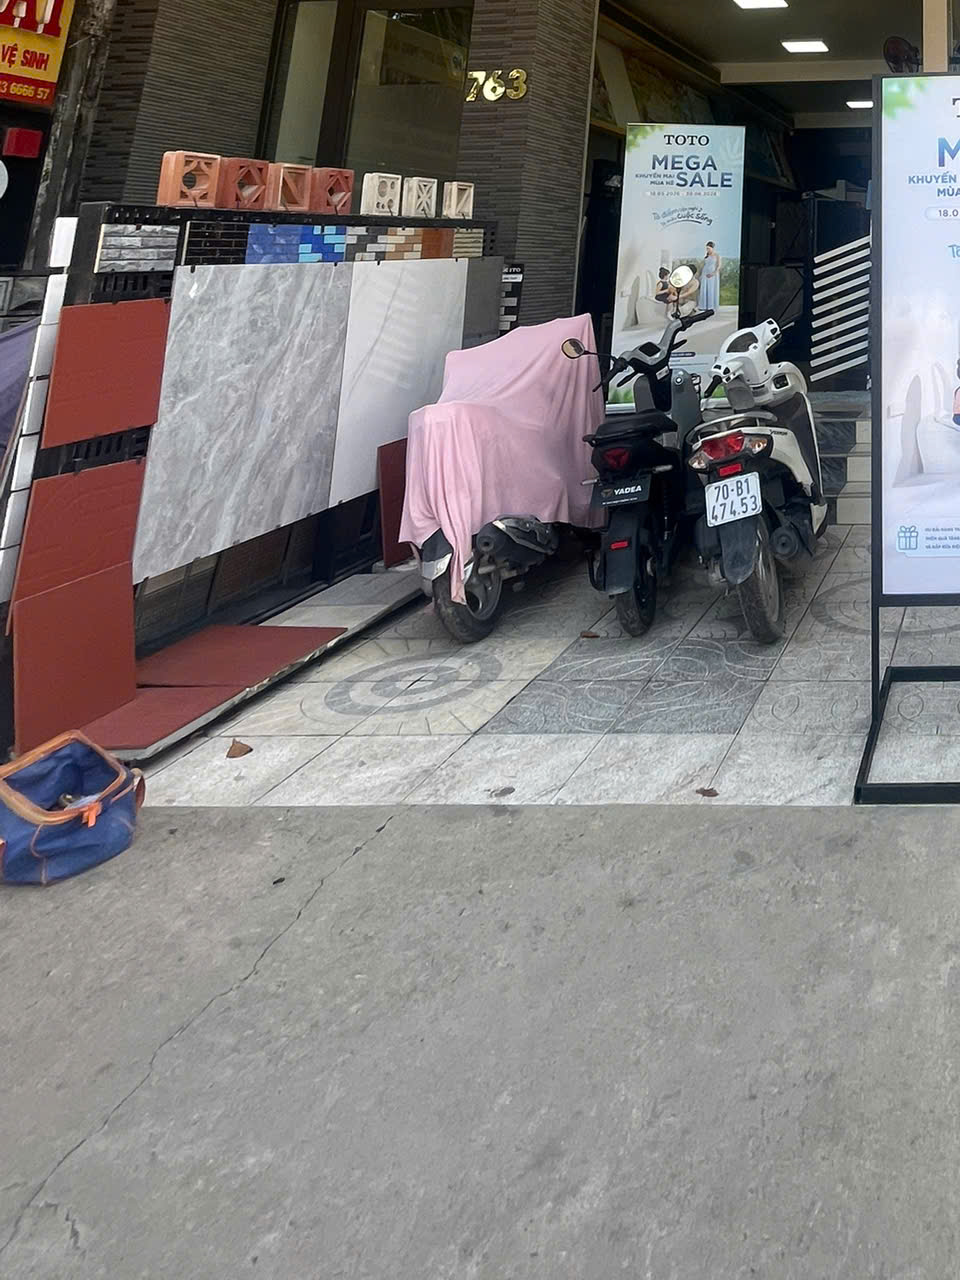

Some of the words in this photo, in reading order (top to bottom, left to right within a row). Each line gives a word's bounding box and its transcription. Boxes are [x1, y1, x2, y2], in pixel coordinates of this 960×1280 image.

[1, 43, 19, 68] VỆ
[21, 49, 50, 71] SINH
[465, 68, 528, 102] 763
[36, 88, 50, 100] 57
[663, 134, 710, 147] TOTO
[651, 154, 718, 171] MEGA
[675, 171, 733, 188] SALE
[908, 170, 958, 185] KHUYẾN
[614, 485, 642, 495] YADEA
[714, 477, 751, 502] 70-B1
[711, 495, 758, 522] 474.53
